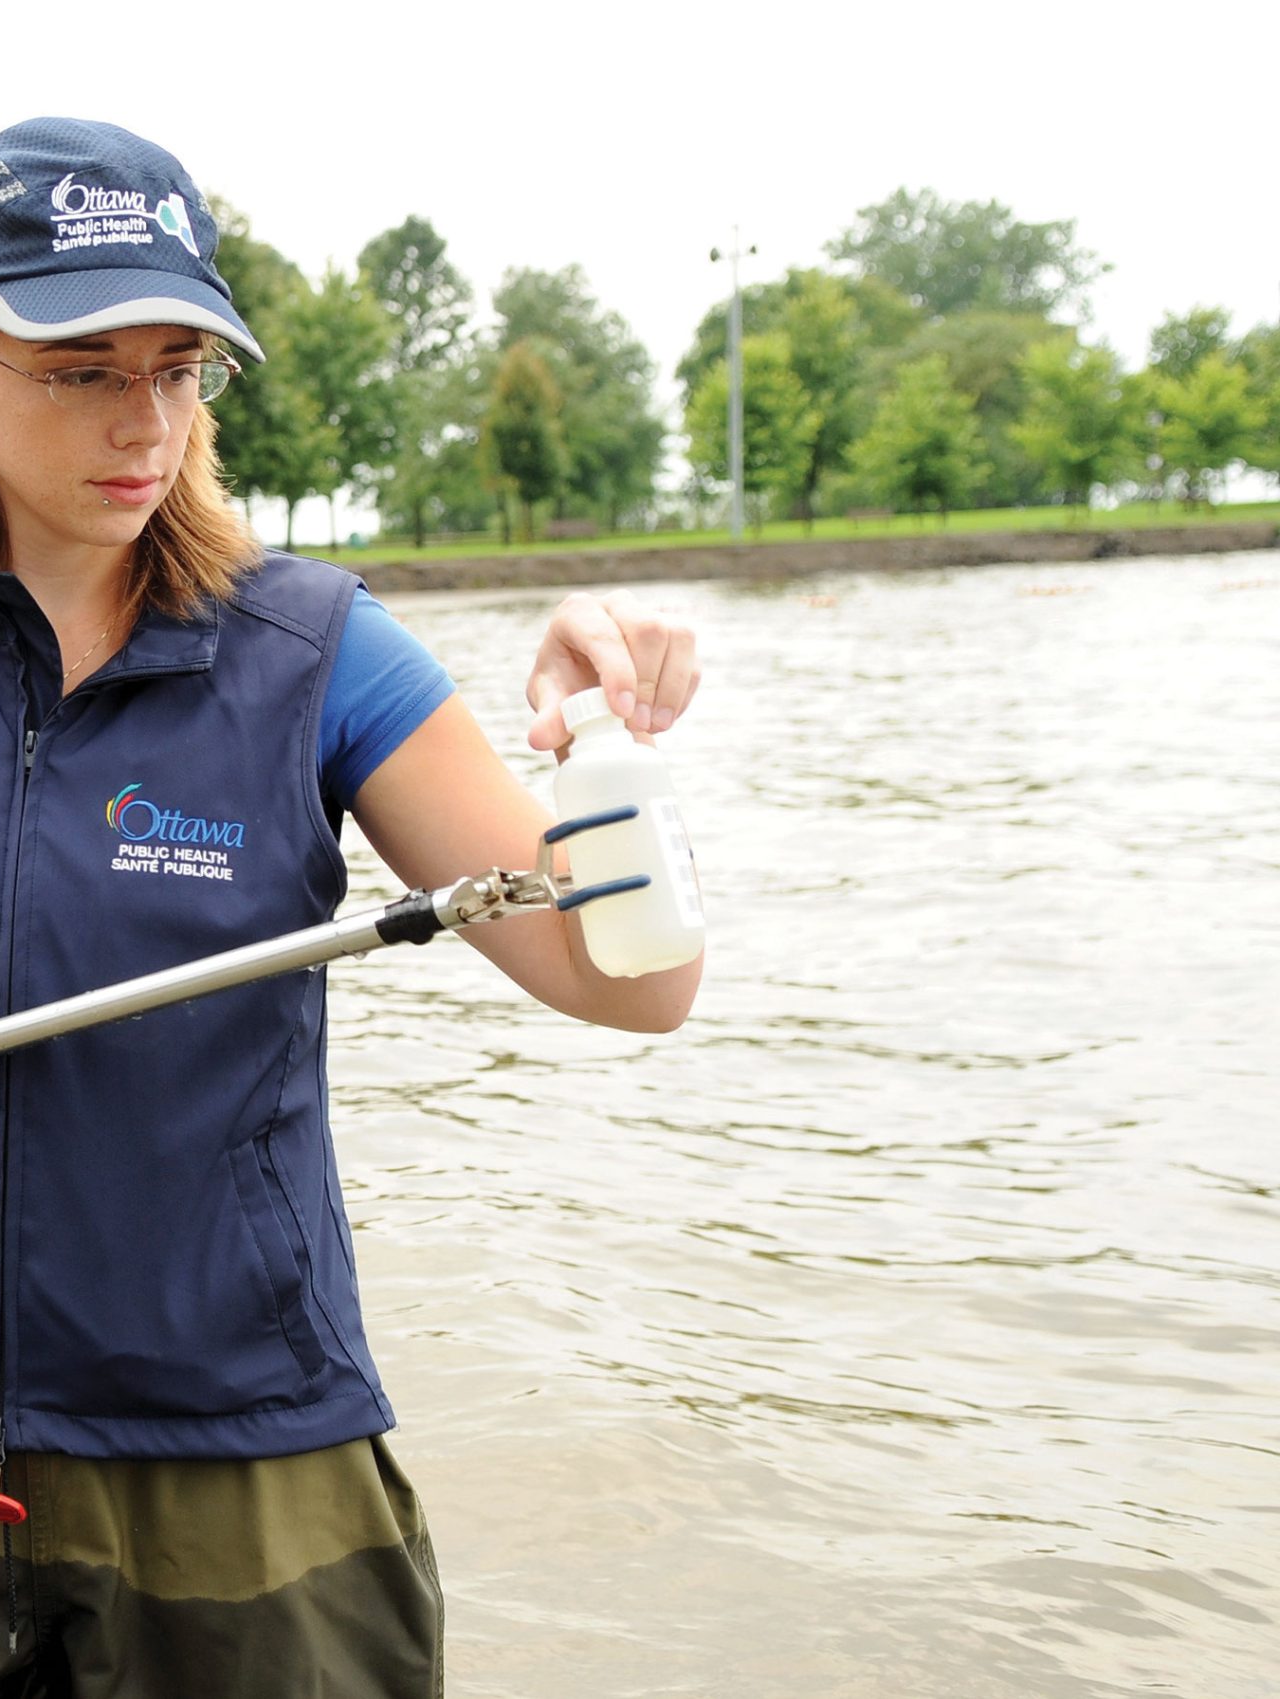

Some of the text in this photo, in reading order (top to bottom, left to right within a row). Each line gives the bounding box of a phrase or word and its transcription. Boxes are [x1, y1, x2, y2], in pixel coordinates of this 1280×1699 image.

[56, 175, 147, 214] Ottawa
[57, 217, 147, 237] Public Health
[52, 231, 154, 253] Santé publique
[117, 795, 245, 848] Ottawa
[118, 844, 228, 865] PUBLIC HEALTH
[111, 857, 233, 881] SANTÉ PUBLIQUE
